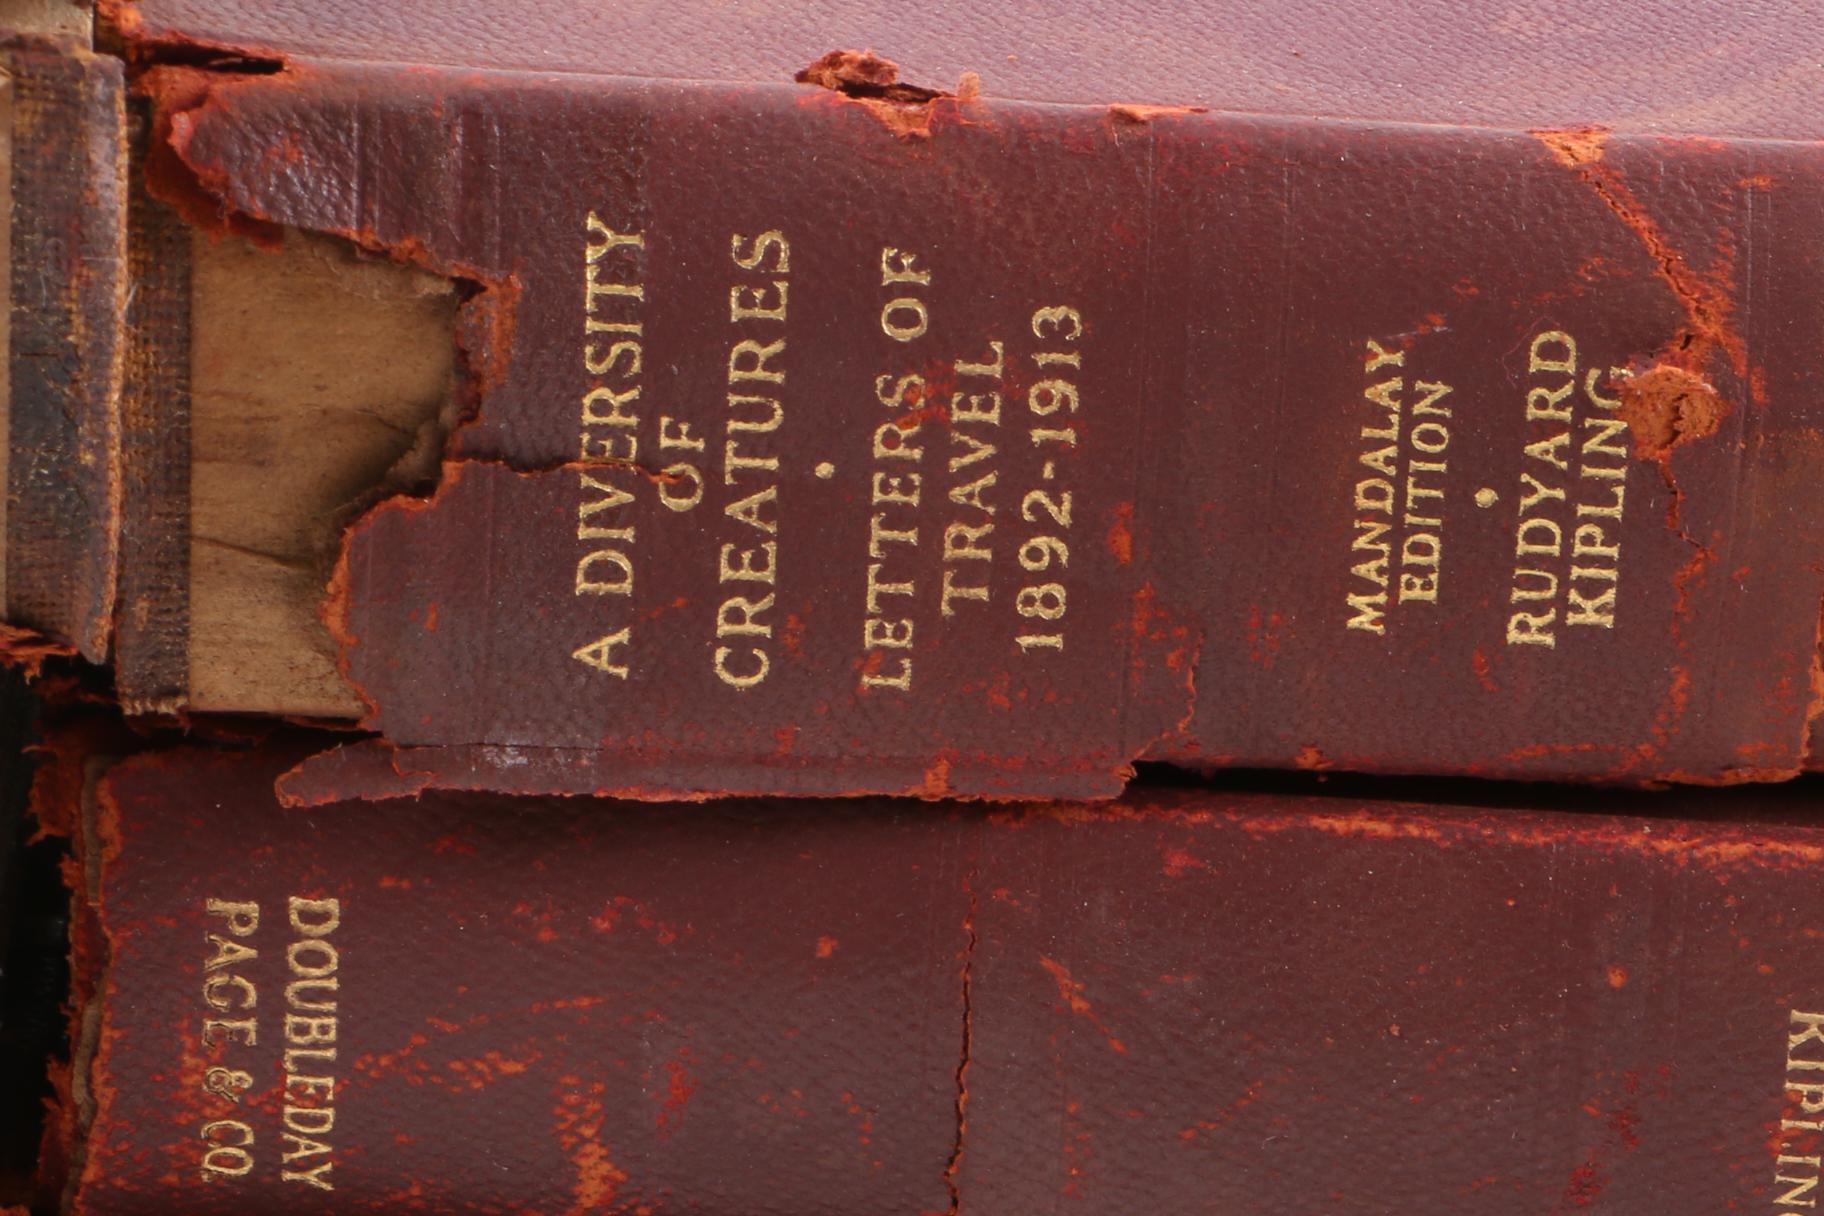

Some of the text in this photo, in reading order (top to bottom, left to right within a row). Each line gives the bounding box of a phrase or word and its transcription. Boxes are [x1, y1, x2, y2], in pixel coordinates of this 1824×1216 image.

[572, 211, 645, 680] A DIVERSITY
[658, 416, 705, 512] OF
[714, 229, 790, 688] CREATURES
[862, 247, 931, 691] LETTERS OF
[941, 340, 1004, 616] TRAVEL
[1014, 305, 1082, 651] 1892-1913
[1346, 340, 1405, 635] MANDALAY
[1398, 380, 1453, 604] EDITION
[1507, 330, 1576, 650] RUDYARD
[202, 898, 260, 1048] PAGE
[203, 1067, 253, 1102] &
[281, 896, 340, 1191] DOUBLEDAY
